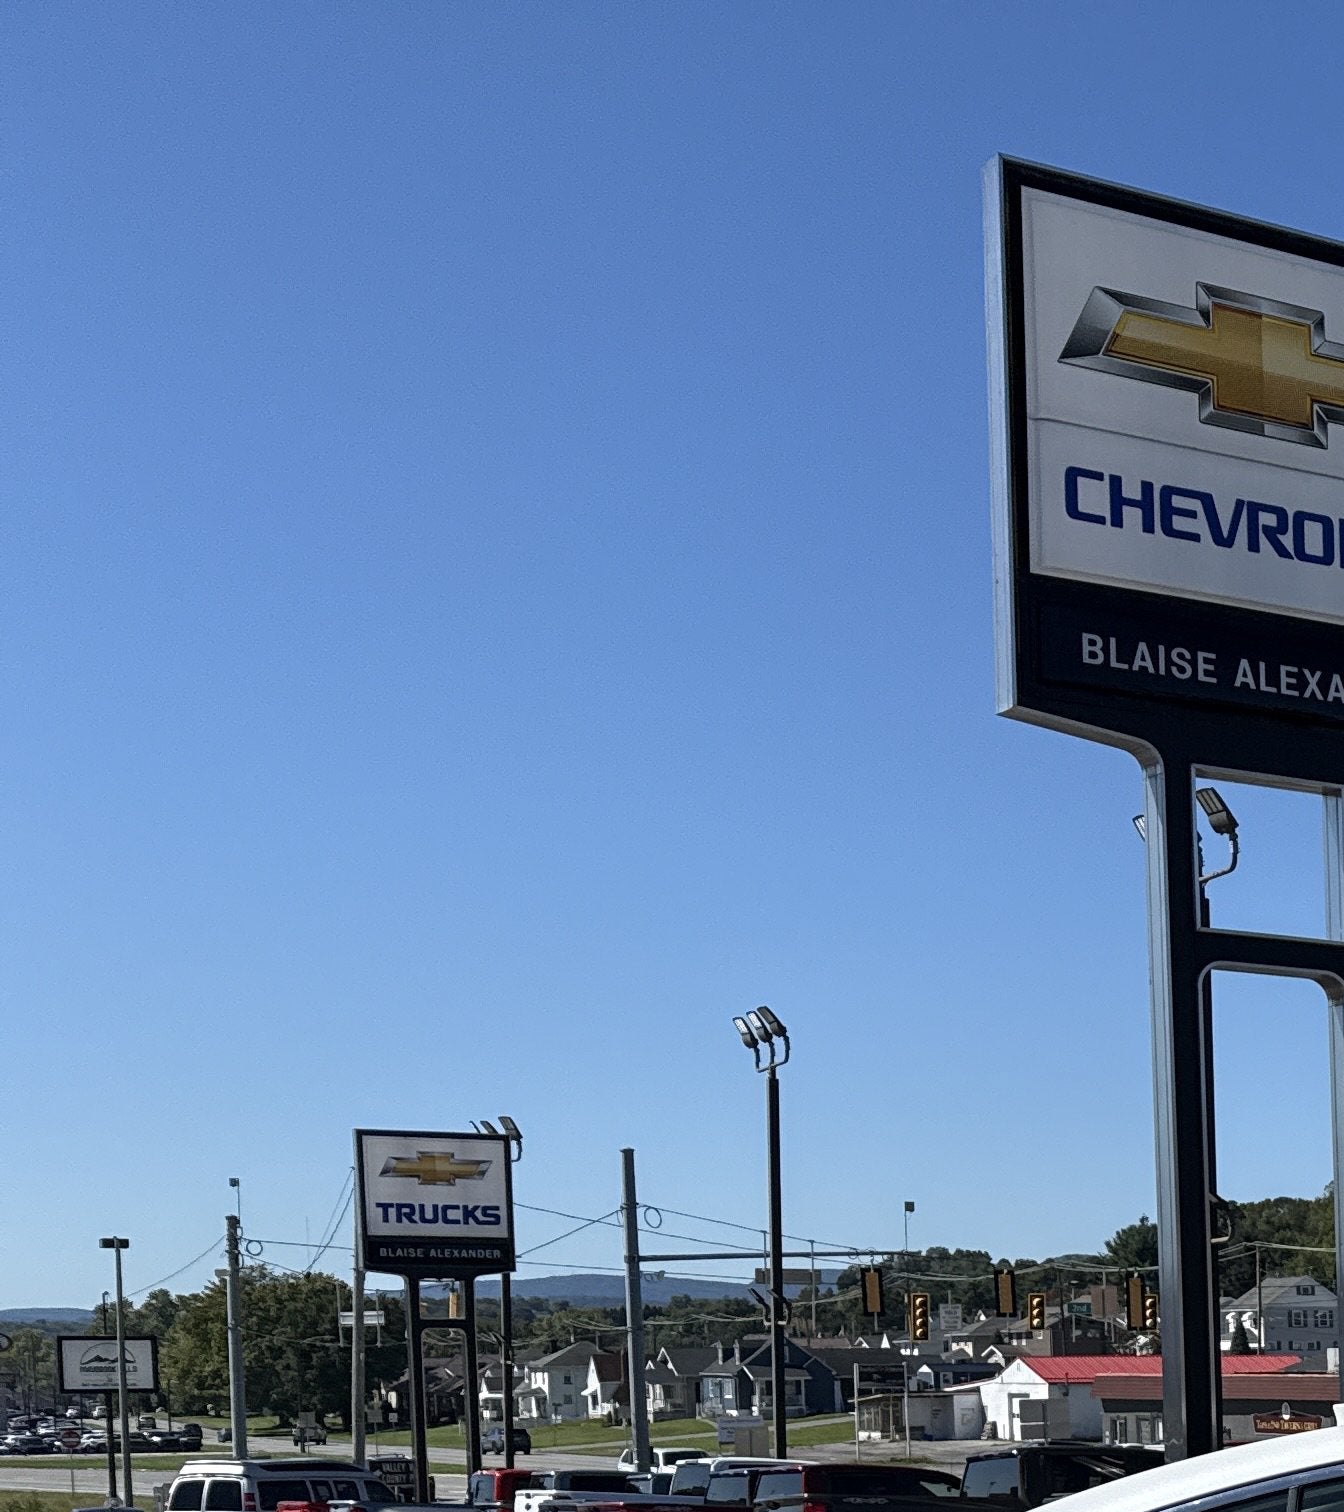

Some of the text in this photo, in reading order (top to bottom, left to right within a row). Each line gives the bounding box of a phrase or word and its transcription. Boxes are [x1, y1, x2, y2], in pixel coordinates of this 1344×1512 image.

[1081, 631, 1218, 684] BLAISE
[375, 1202, 501, 1225] TRUCKS
[379, 1247, 501, 1259] BLAISE ALEXANDER
[1072, 1304, 1087, 1312] 2nd
